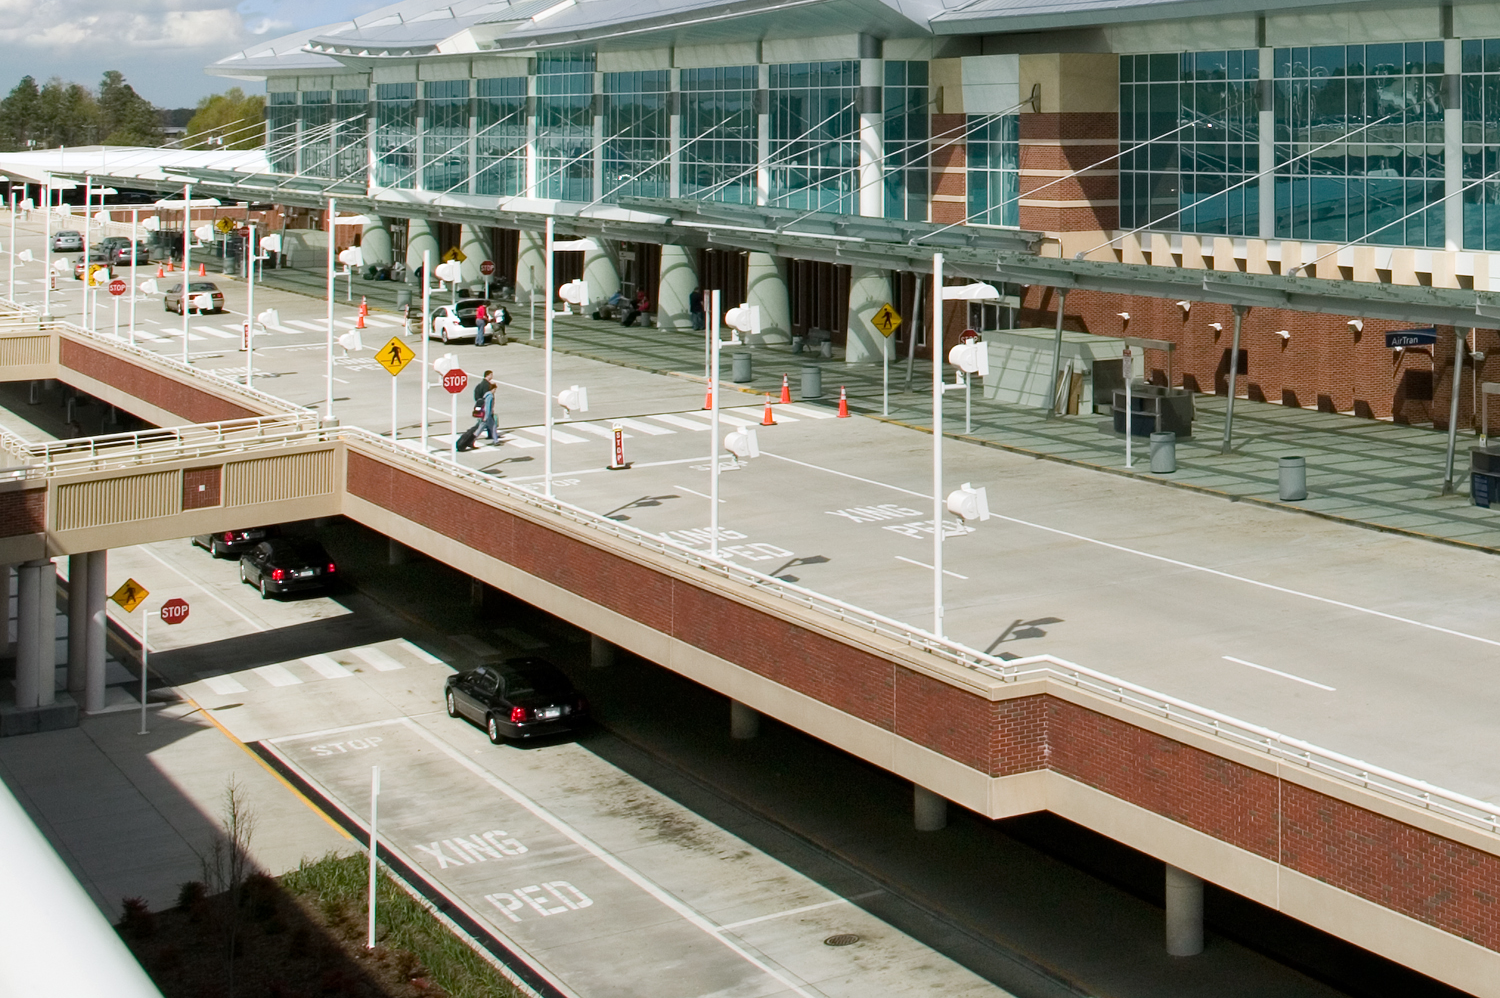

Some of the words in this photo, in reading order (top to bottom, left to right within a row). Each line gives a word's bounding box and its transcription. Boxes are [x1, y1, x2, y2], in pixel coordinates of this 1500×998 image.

[1391, 336, 1419, 346] AirTran
[444, 375, 467, 387] STOP
[824, 504, 924, 523] XING
[162, 605, 188, 618] STOP
[310, 736, 383, 756] STOP
[414, 829, 529, 869] XING
[484, 880, 594, 923] PED
